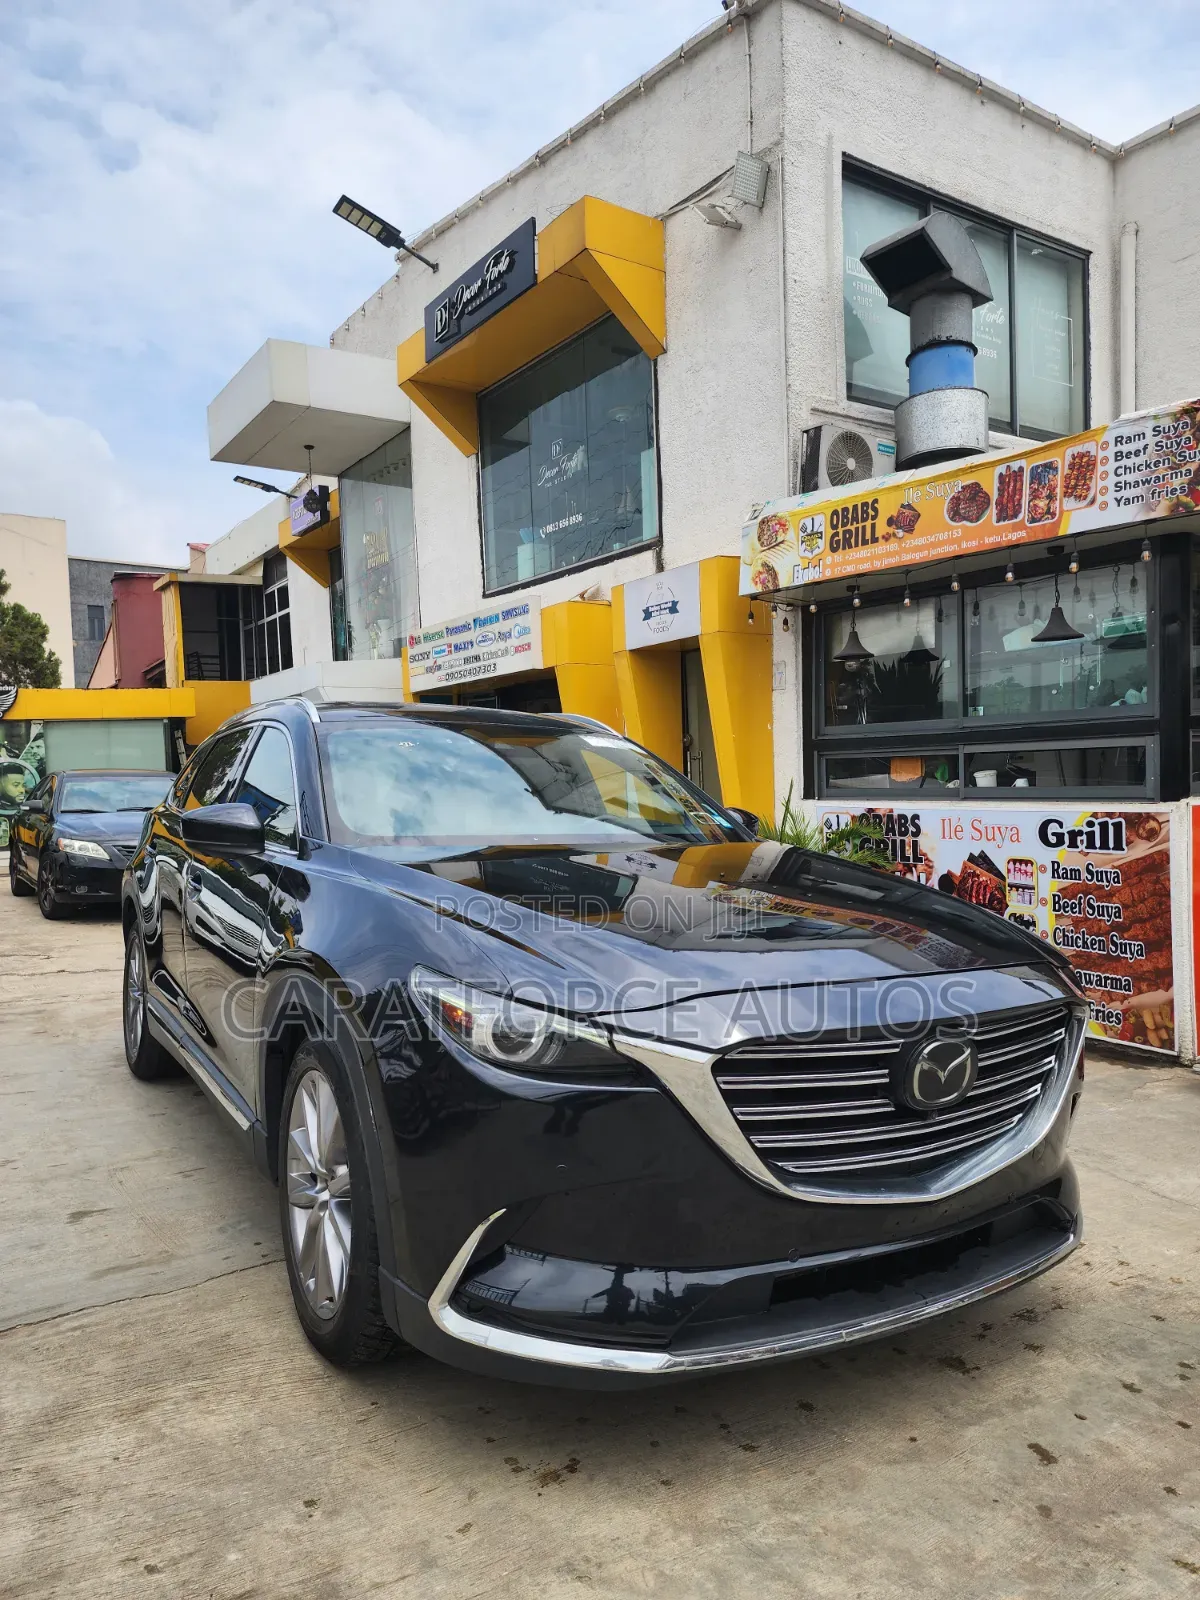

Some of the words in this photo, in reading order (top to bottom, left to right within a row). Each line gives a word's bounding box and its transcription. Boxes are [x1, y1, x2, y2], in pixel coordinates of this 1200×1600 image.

[1114, 431, 1146, 447] Ram
[1152, 420, 1190, 438] Suya
[1114, 443, 1149, 462] Beef
[1154, 435, 1192, 452] Suya
[1114, 456, 1171, 478] Chicken
[1177, 450, 1200, 463] Su
[926, 479, 963, 500] Suya
[1114, 468, 1192, 493] Shawarma
[1114, 494, 1145, 508] Yam
[1150, 485, 1187, 500] fries
[830, 497, 879, 531] OBABS
[829, 522, 879, 553] GRILL
[873, 560, 882, 568] by
[901, 550, 929, 562] Balogun
[445, 620, 472, 637] Panasonic
[501, 603, 530, 621] SAMSUNG
[409, 651, 431, 663] SONY
[445, 663, 497, 682] 09050407303
[940, 816, 964, 840] Ilé
[970, 818, 1021, 849] Suya
[1037, 818, 1126, 851] Grill
[858, 837, 924, 863] GRILL
[1051, 860, 1082, 881] Ram
[1085, 862, 1121, 888] Suya
[1052, 893, 1084, 915] Beef
[1086, 896, 1122, 923] Suya
[1053, 927, 1106, 951] Chicken
[1109, 933, 1145, 960] Suya
[1075, 969, 1132, 993] awarma
